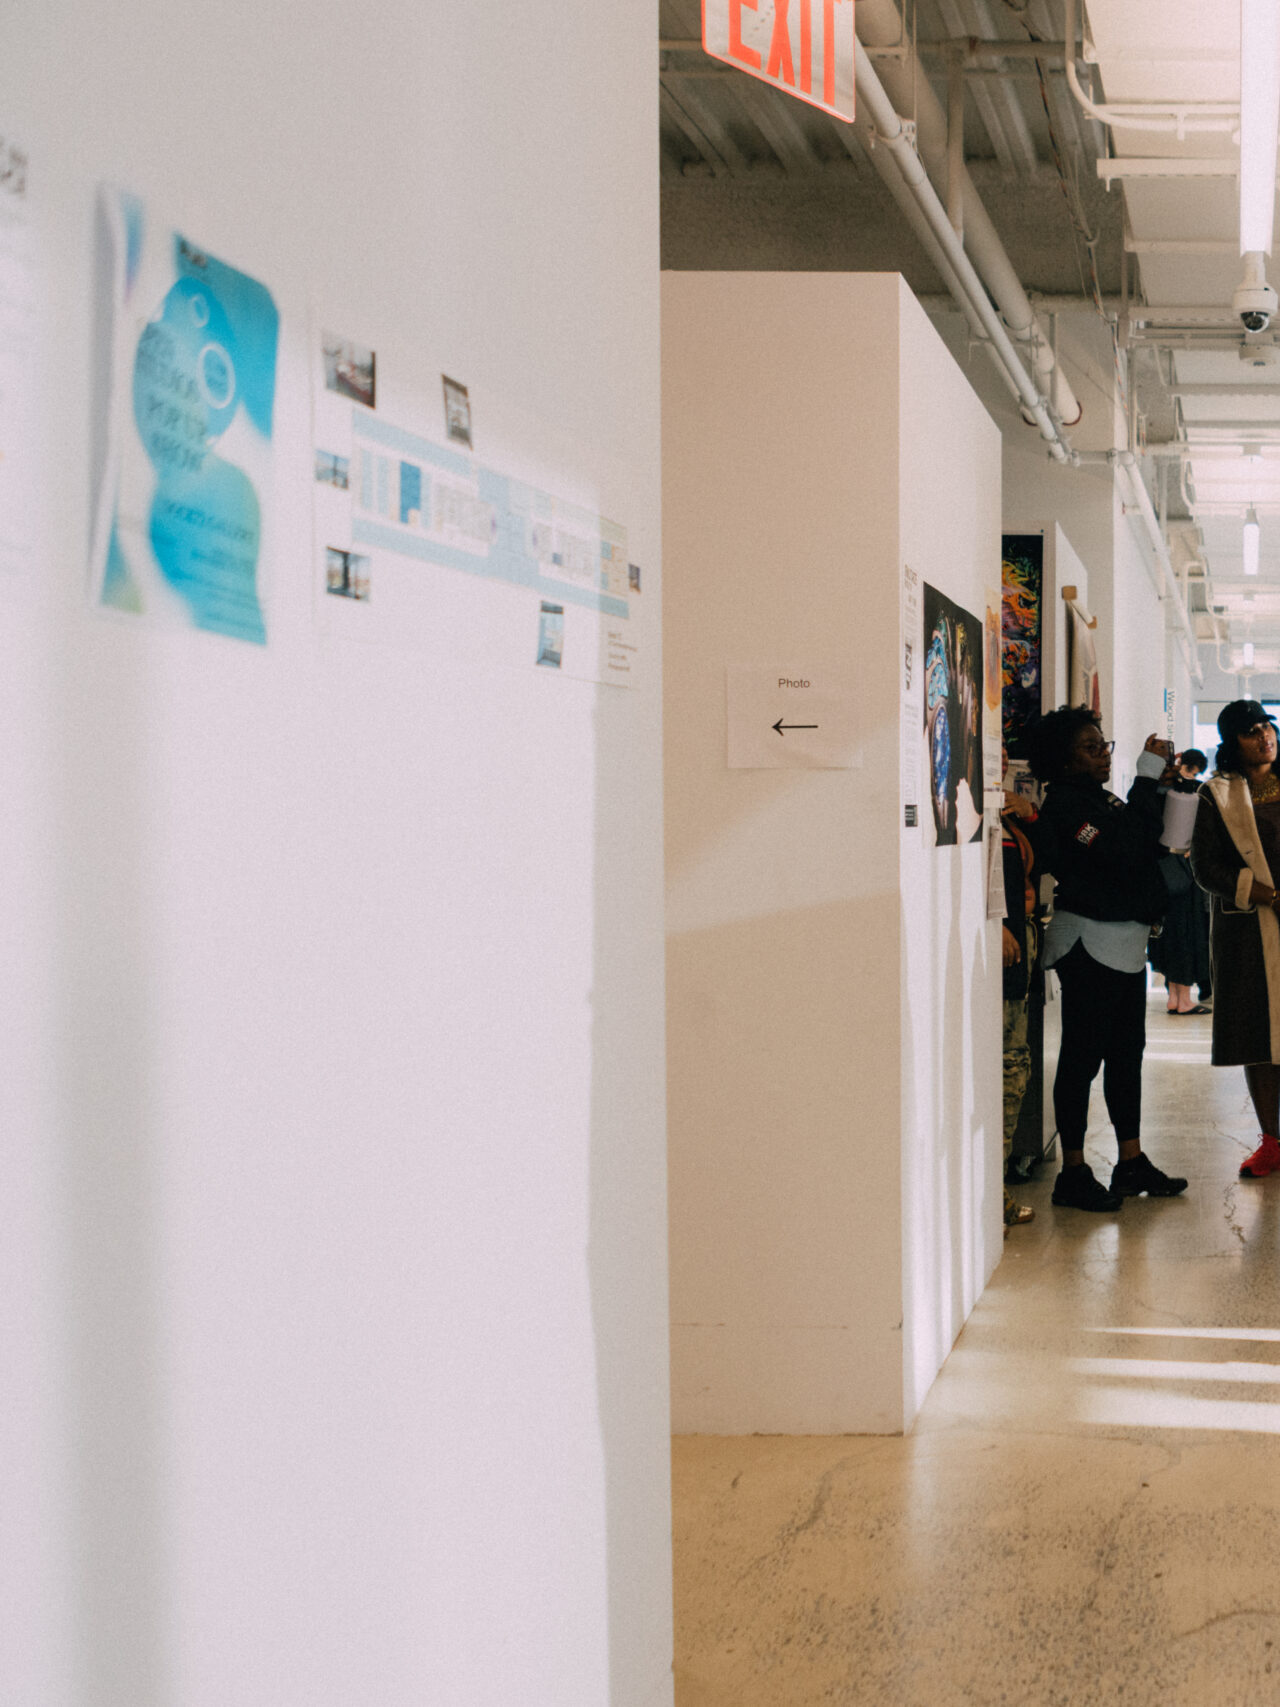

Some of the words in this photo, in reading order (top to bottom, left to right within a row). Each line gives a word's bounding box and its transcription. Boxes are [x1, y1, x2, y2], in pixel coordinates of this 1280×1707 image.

[728, 0, 841, 107] EXIT
[778, 678, 811, 689] Photo
[1167, 691, 1176, 722] Wood
